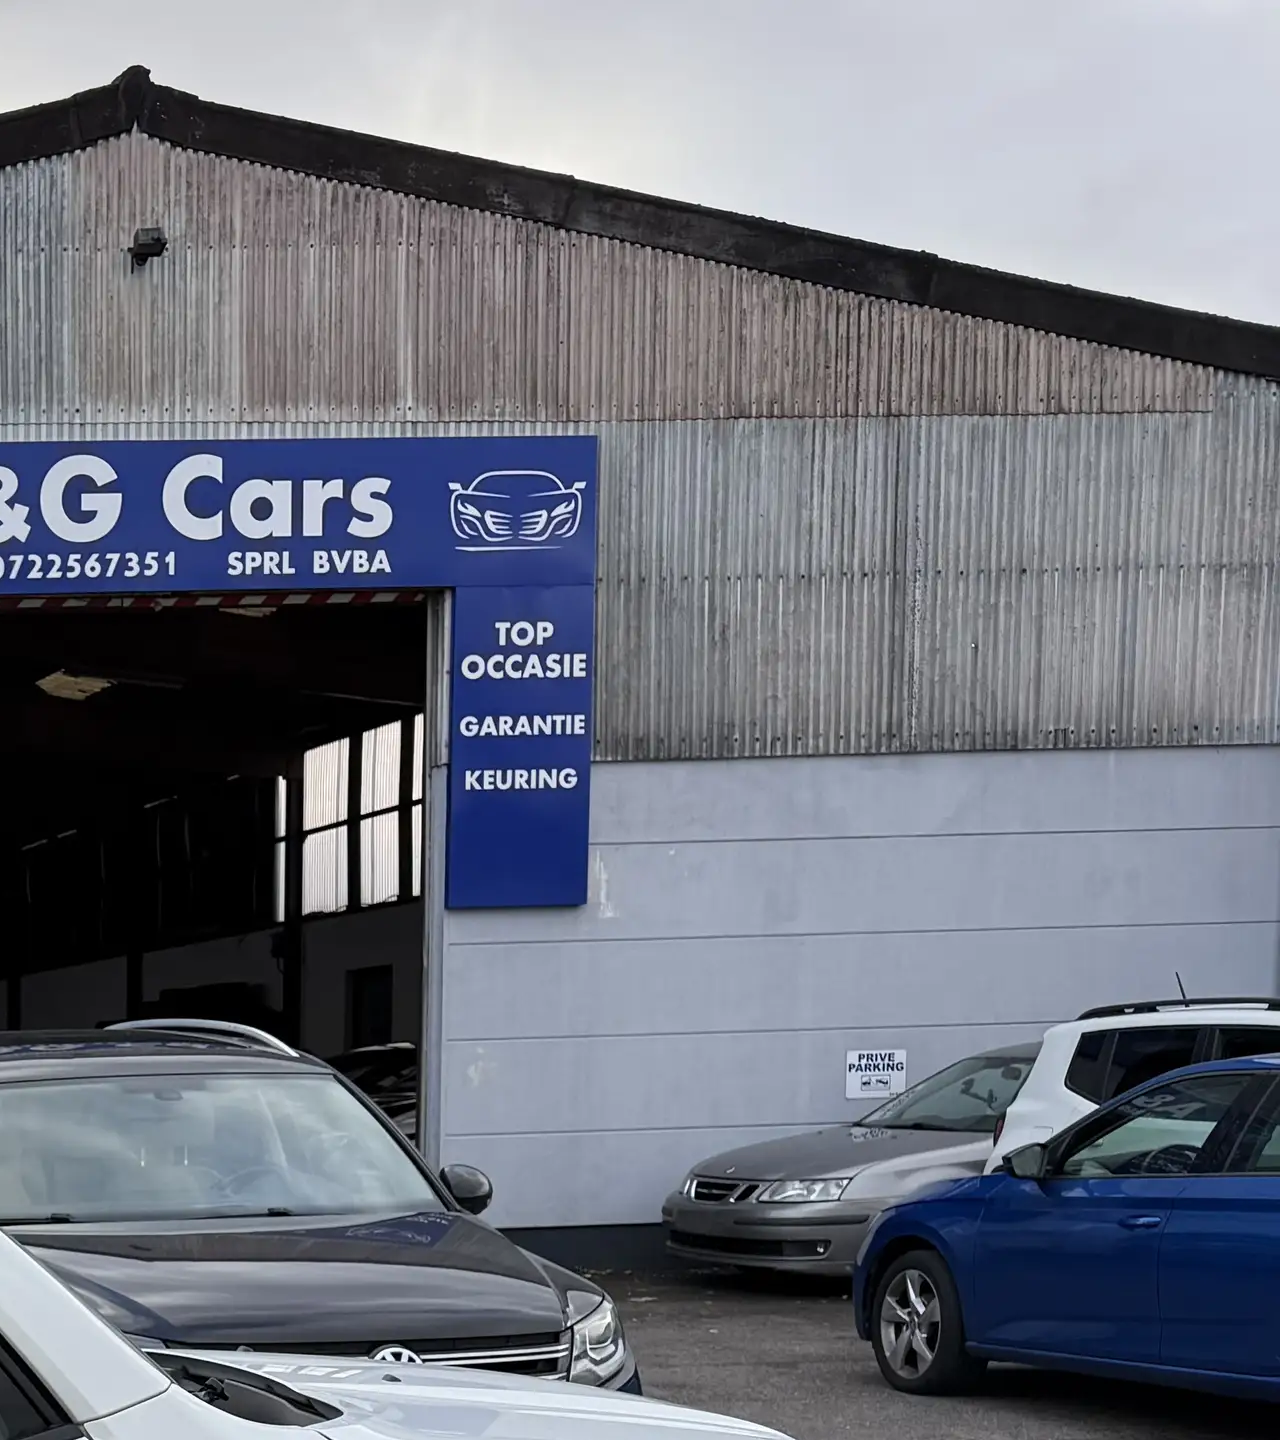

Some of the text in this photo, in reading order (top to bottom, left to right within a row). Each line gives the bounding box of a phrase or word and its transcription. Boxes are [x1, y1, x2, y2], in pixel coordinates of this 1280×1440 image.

[162, 453, 393, 541] Cars
[227, 550, 296, 576] SPRL
[313, 549, 392, 574] BVBA
[494, 620, 554, 647] TOP
[461, 653, 587, 680] OCCASIE
[459, 714, 586, 737] GARANTIE
[465, 767, 578, 791] KEURING
[848, 1062, 905, 1073] PARKING
[858, 1052, 895, 1062] PRIVE
